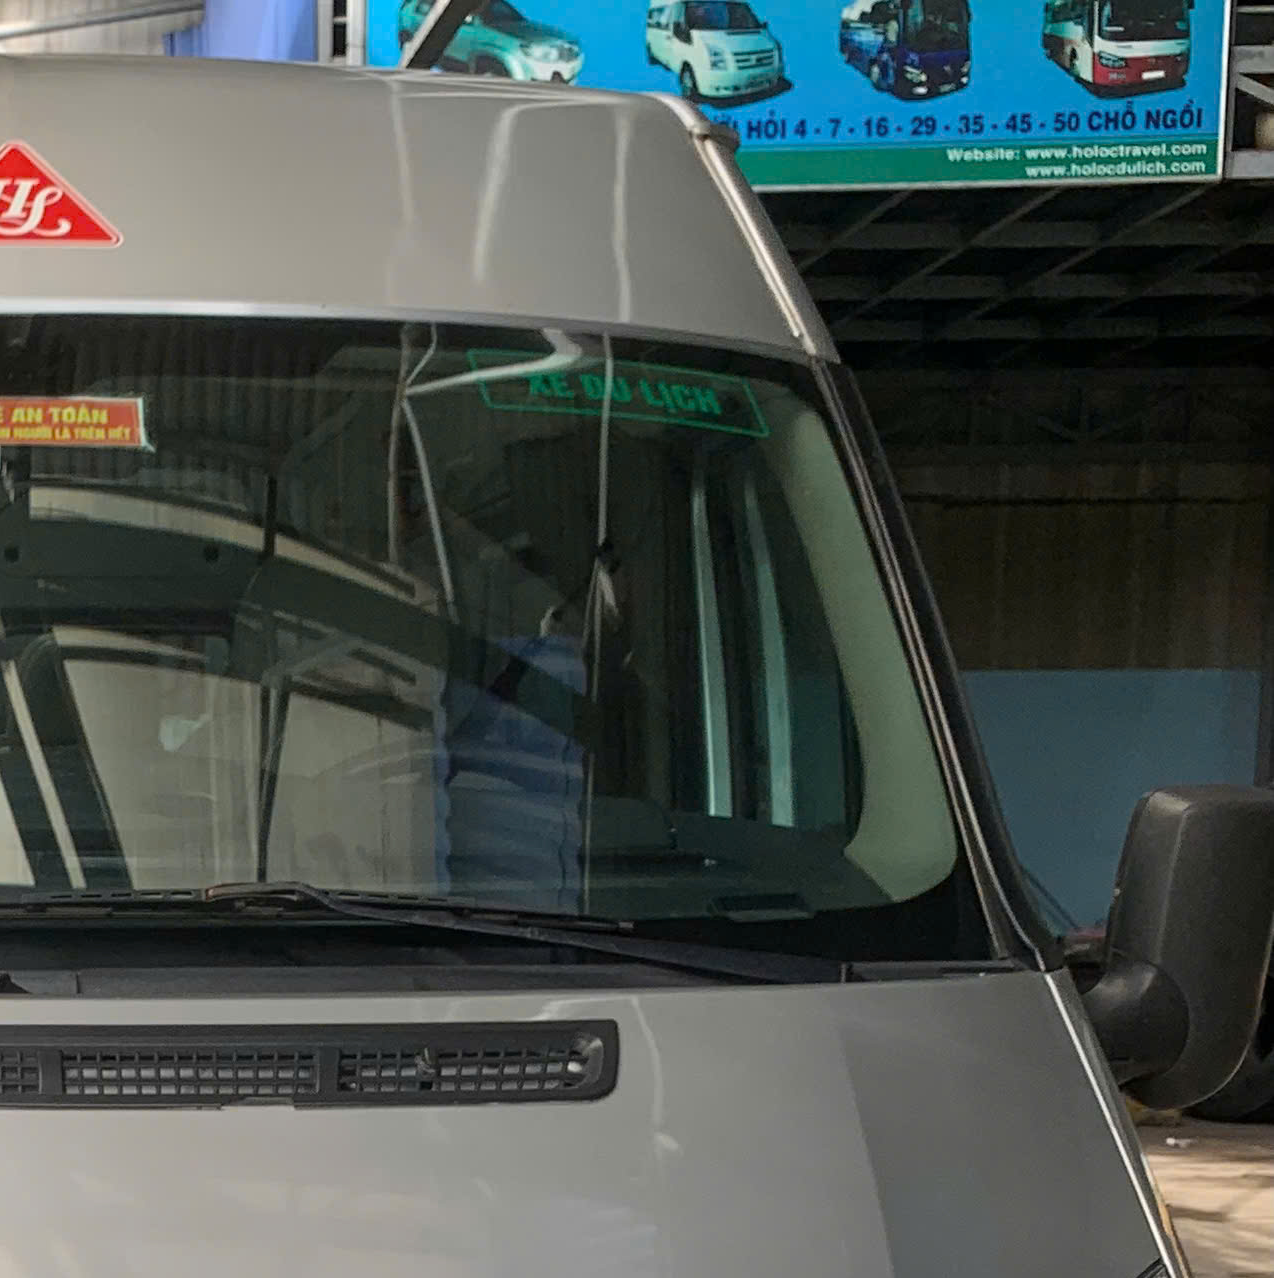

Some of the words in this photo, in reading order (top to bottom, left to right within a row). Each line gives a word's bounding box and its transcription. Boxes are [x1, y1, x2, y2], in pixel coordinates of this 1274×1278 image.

[794, 118, 807, 138] 4
[829, 118, 842, 138] 7
[863, 117, 889, 137] 16
[910, 116, 937, 136] 29
[957, 114, 984, 135] 35
[1005, 113, 1032, 133] 45
[1053, 112, 1080, 132] 50
[947, 147, 1020, 163] Website:
[1025, 143, 1207, 161] www.holoctravel.com
[1025, 159, 1206, 178] www.holocdulich.com
[11, 406, 43, 424] AN
